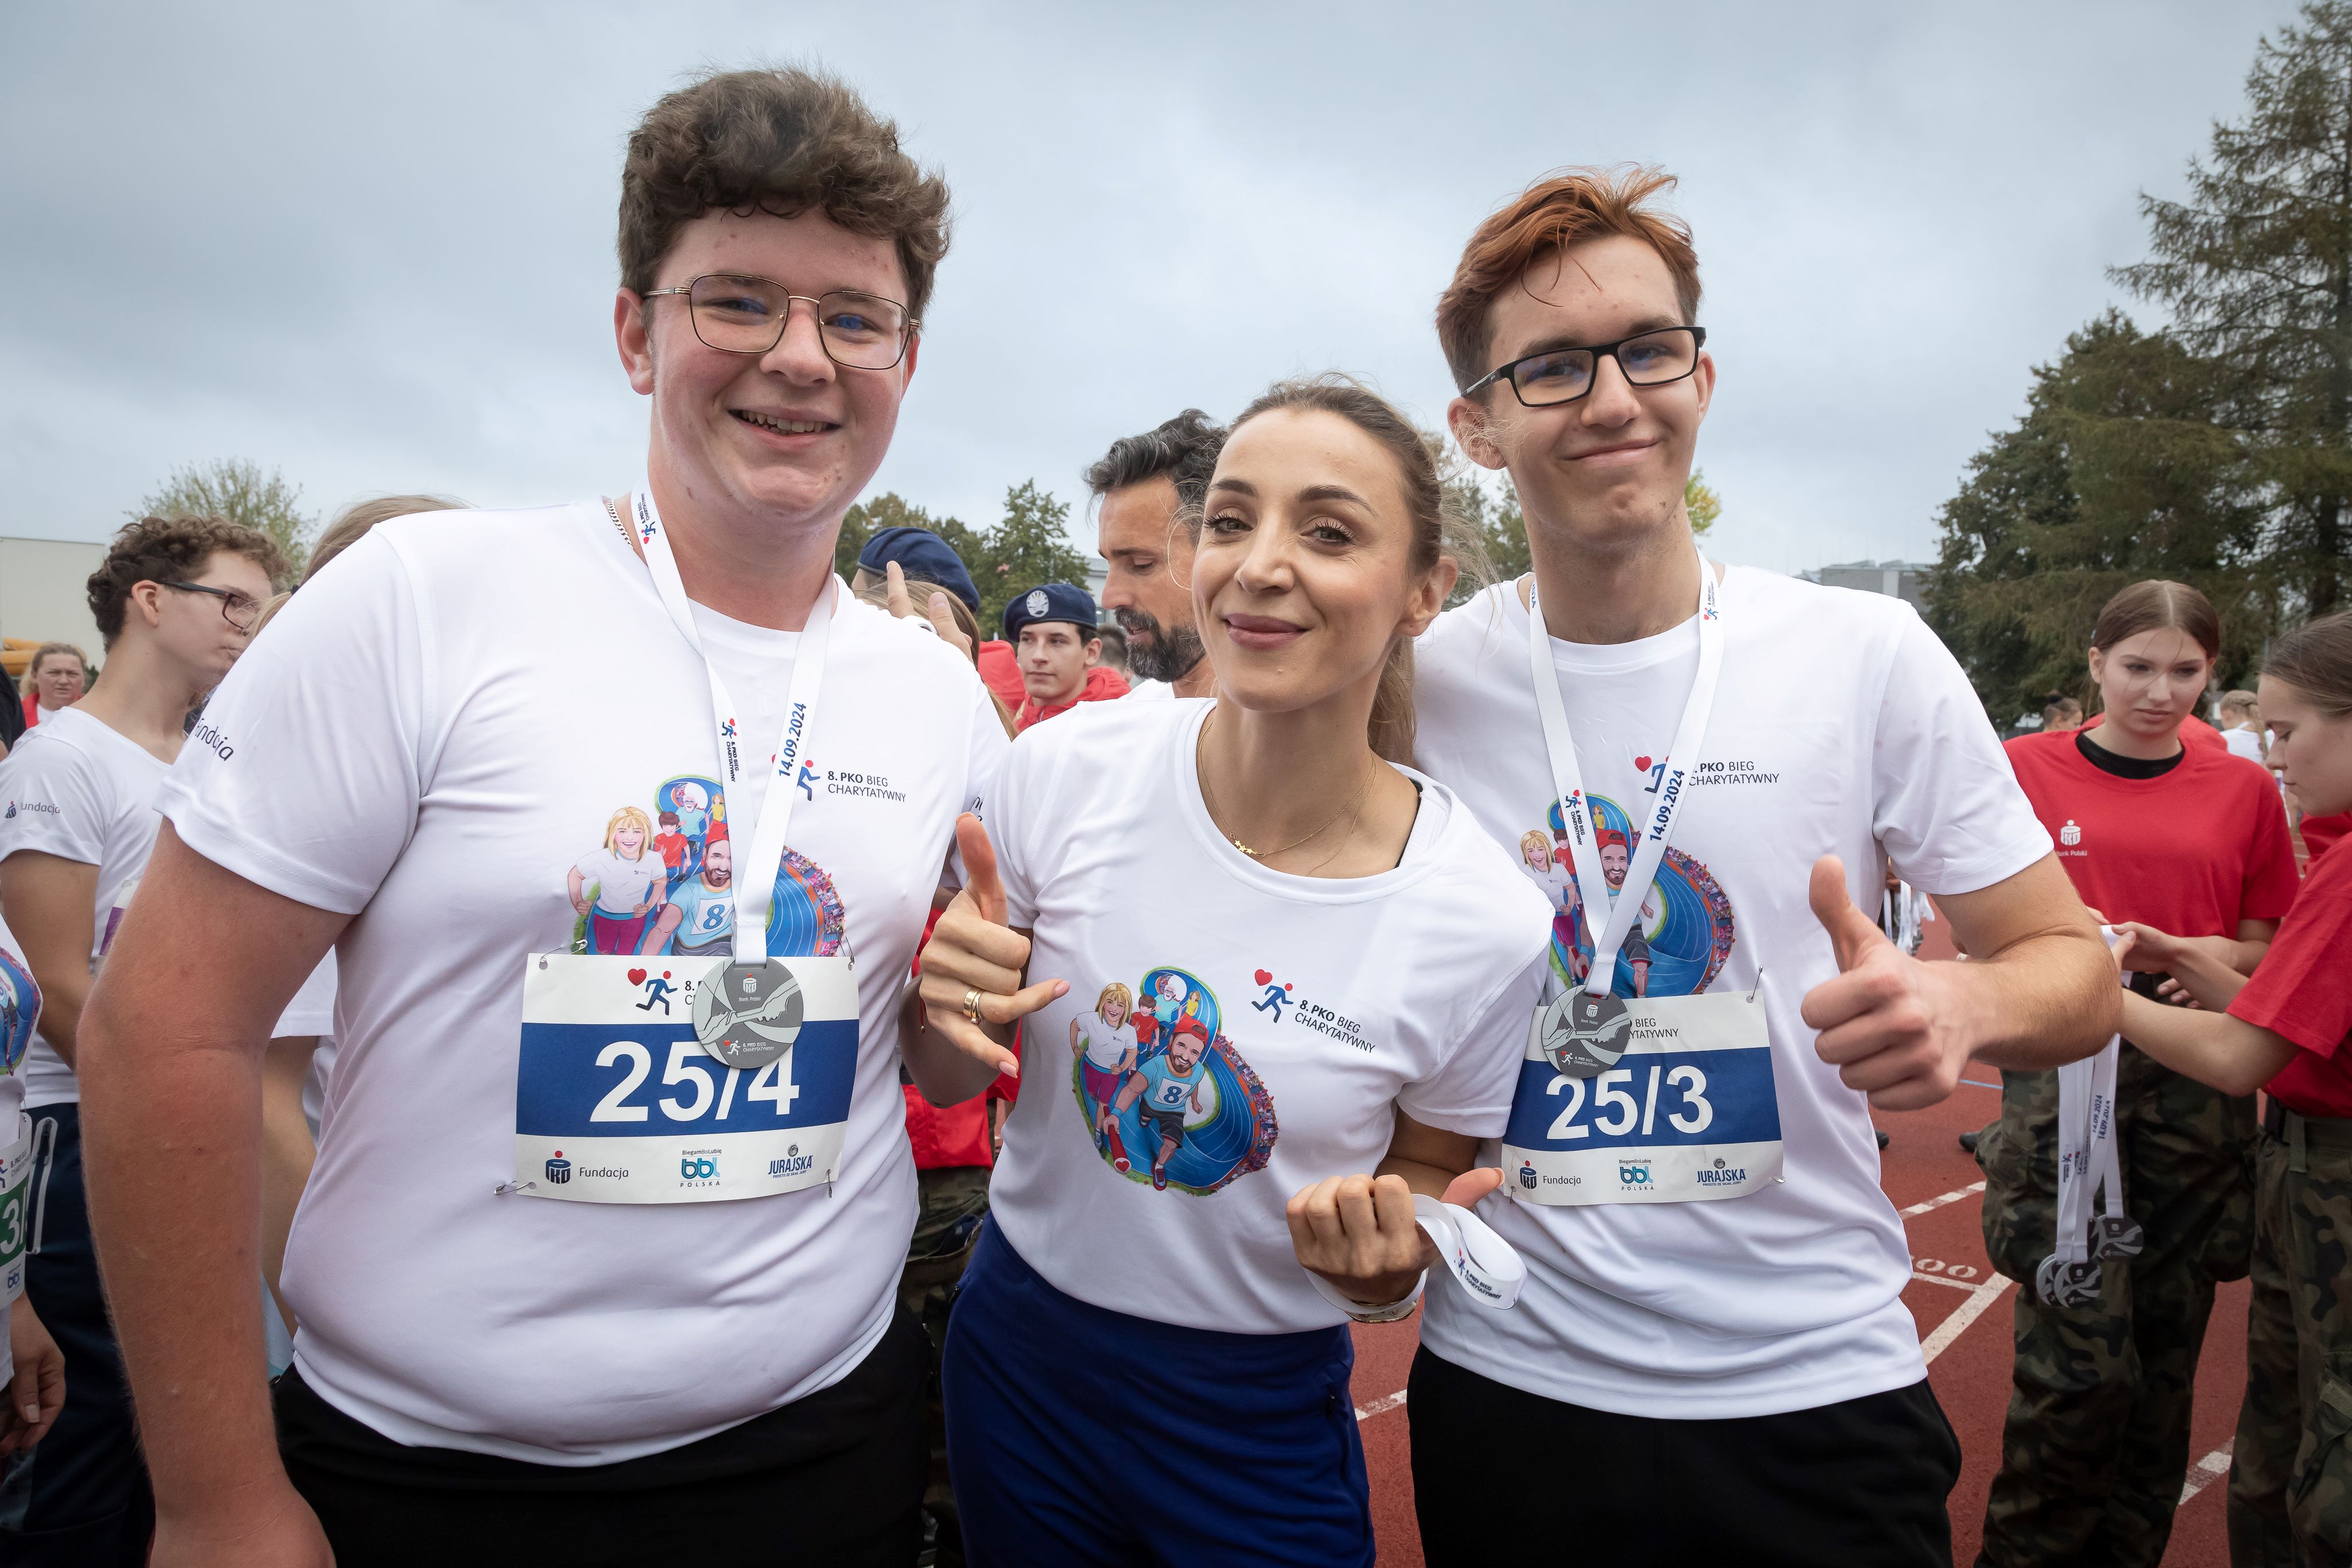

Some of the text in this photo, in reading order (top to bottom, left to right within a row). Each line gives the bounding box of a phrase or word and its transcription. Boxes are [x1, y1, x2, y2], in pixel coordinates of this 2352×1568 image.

[779, 702, 806, 776] 14.09.2024
[726, 741, 736, 782] CHARYTATYWNY
[1700, 761, 1754, 773] PKO BIEG
[827, 771, 888, 787] 8. PKO BIEG
[1689, 773, 1780, 786] CHARYTATYWNY
[828, 783, 906, 802] CHARYTATYWNY
[1650, 770, 1685, 841] 14.09.2024
[1570, 811, 1583, 845] CHARYTATYWNY
[703, 904, 725, 930] 8
[685, 980, 695, 991] 8.
[1299, 1000, 1361, 1033] 8. PKO BIEG
[1635, 1017, 1656, 1027] BIEG
[1295, 1012, 1376, 1053] CHARYTATYWNY
[1629, 1028, 1678, 1039] YTATYWNY
[590, 1041, 800, 1122] 25/4
[1163, 1086, 1182, 1104] 8
[1546, 1066, 1713, 1139] 25/3
[579, 1167, 629, 1180] Fundacja
[768, 1155, 813, 1175] JURAJSKA
[1543, 1175, 1581, 1186] Fundacja
[1697, 1169, 1746, 1183] JURAJSKA
